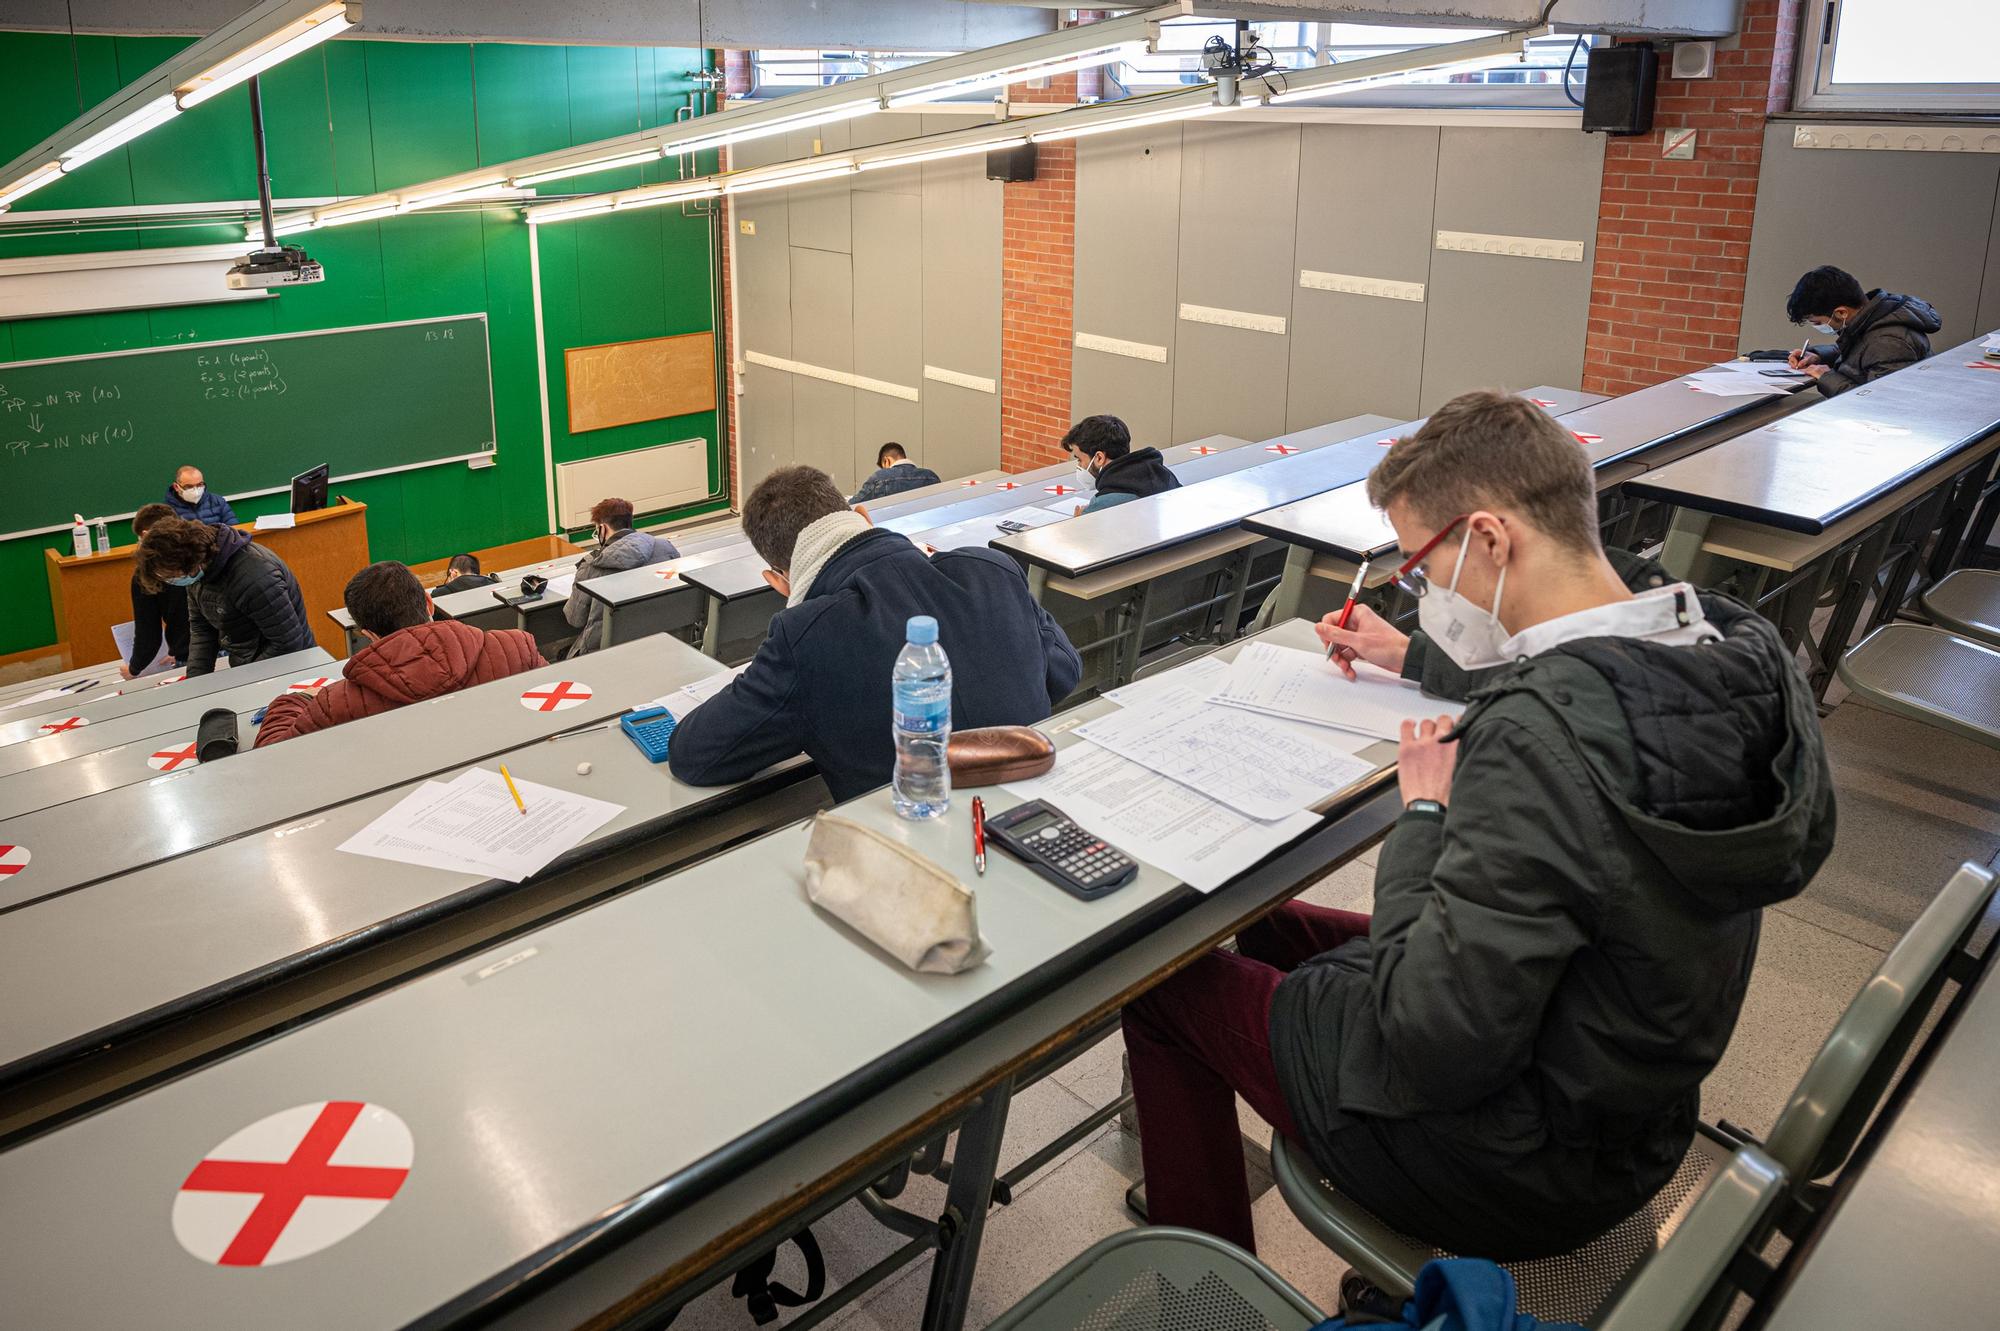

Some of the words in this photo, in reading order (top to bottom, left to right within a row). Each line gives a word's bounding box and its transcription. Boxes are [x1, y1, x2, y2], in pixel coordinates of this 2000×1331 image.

[46, 394, 59, 406] IN
[54, 435, 69, 449] IN
[81, 431, 100, 446] NP
